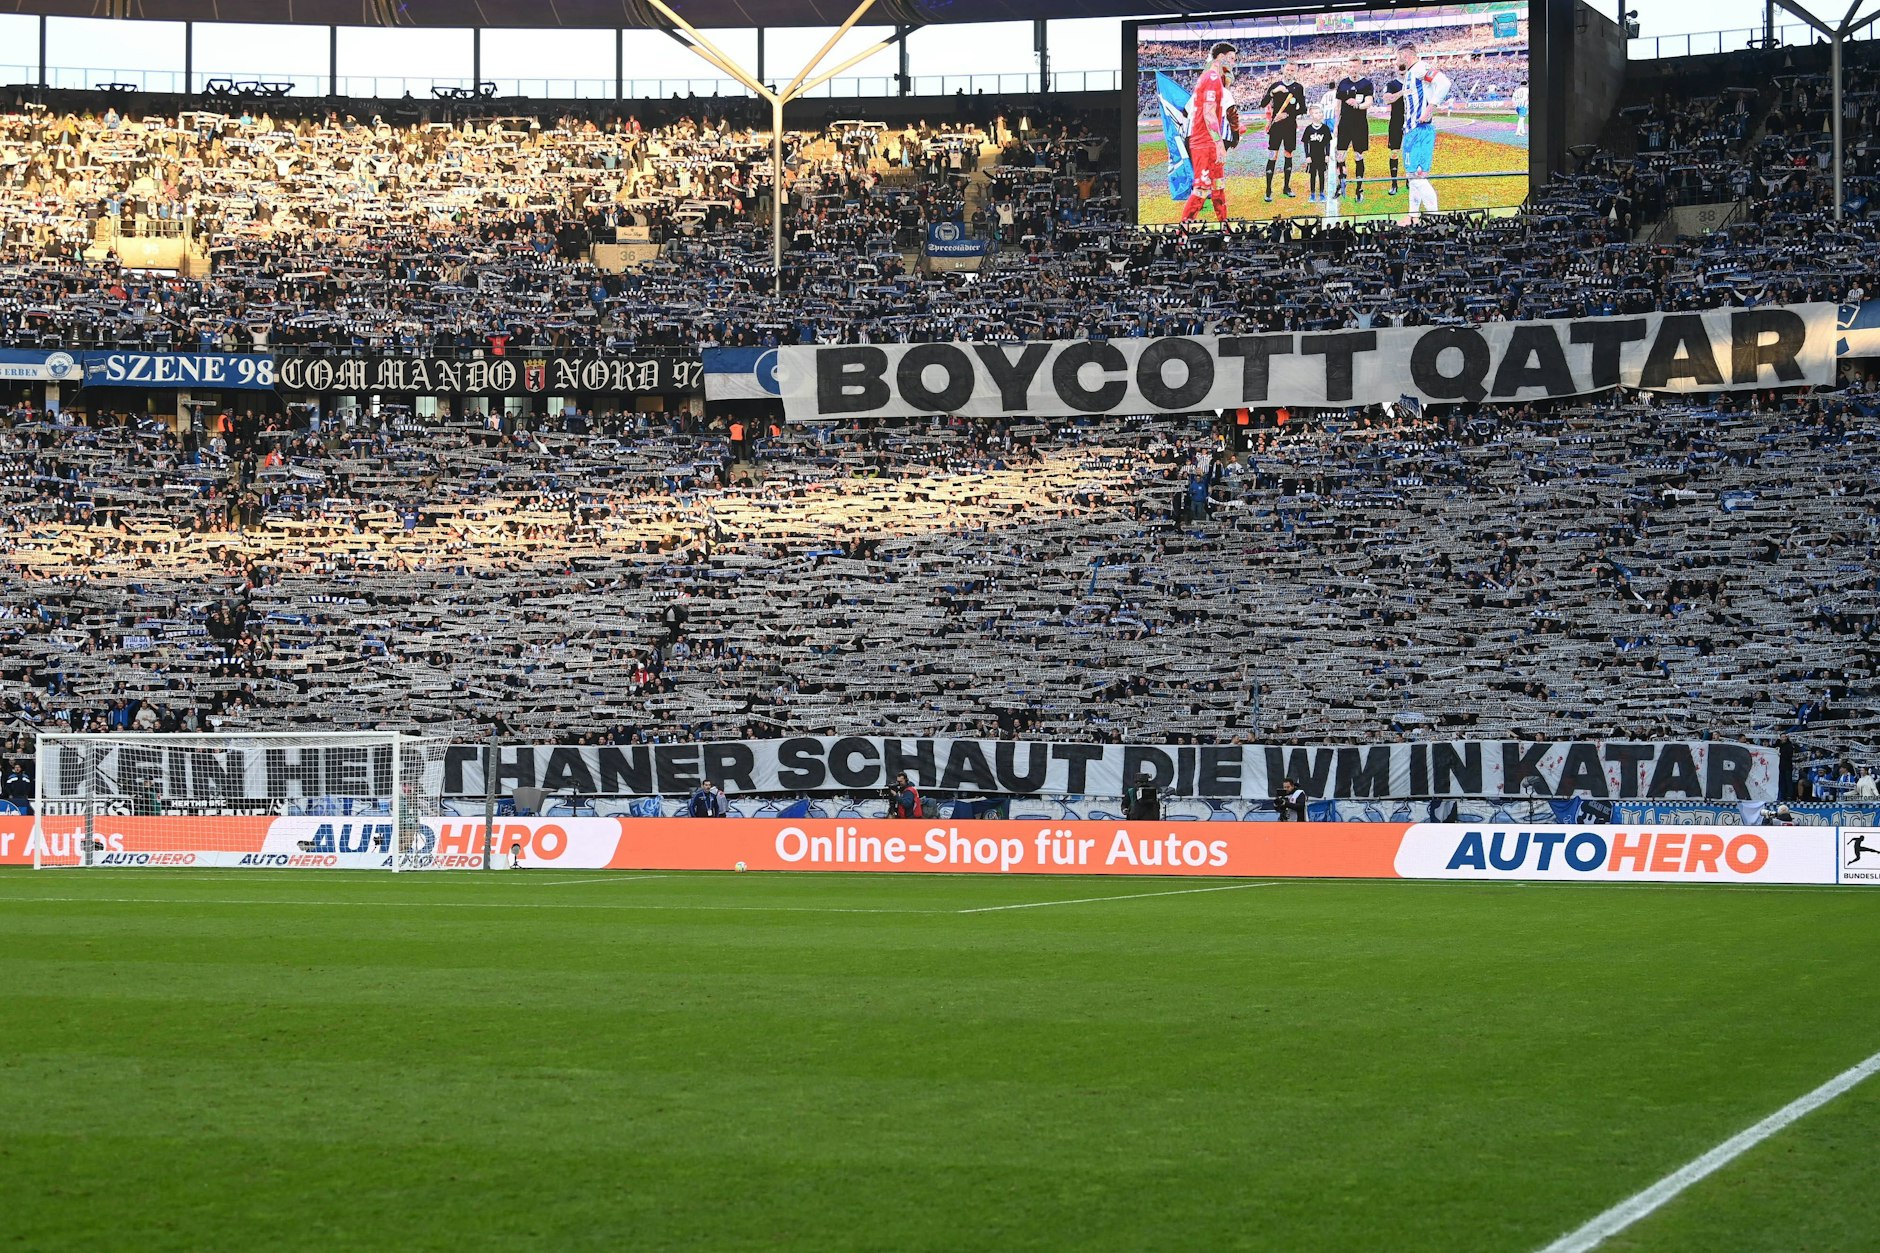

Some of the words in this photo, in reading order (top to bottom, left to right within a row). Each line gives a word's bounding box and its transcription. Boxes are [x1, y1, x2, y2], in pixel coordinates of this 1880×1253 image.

[1310, 132, 1324, 142] sky
[1699, 210, 1715, 222] 38
[620, 251, 635, 261] 36
[816, 331, 1377, 415] BOYCOTT
[1410, 309, 1806, 400] QATAR
[4, 368, 38, 377] ERBEN
[280, 358, 517, 391] COMMANDO
[554, 358, 660, 391] NORD
[59, 746, 246, 798] KEIN
[778, 737, 1104, 794] SCHAUT
[1123, 746, 1243, 797] DIE
[1265, 746, 1391, 797] WM
[1410, 742, 1483, 796] IN
[1502, 743, 1753, 799] KATAR
[775, 827, 1024, 871] Online-Shop
[1035, 829, 1095, 865] für
[1105, 830, 1228, 867] Autos
[1445, 832, 1769, 875] AUTOHERO
[102, 853, 196, 865] AUTOHERO
[239, 853, 338, 866] AUTOHERO
